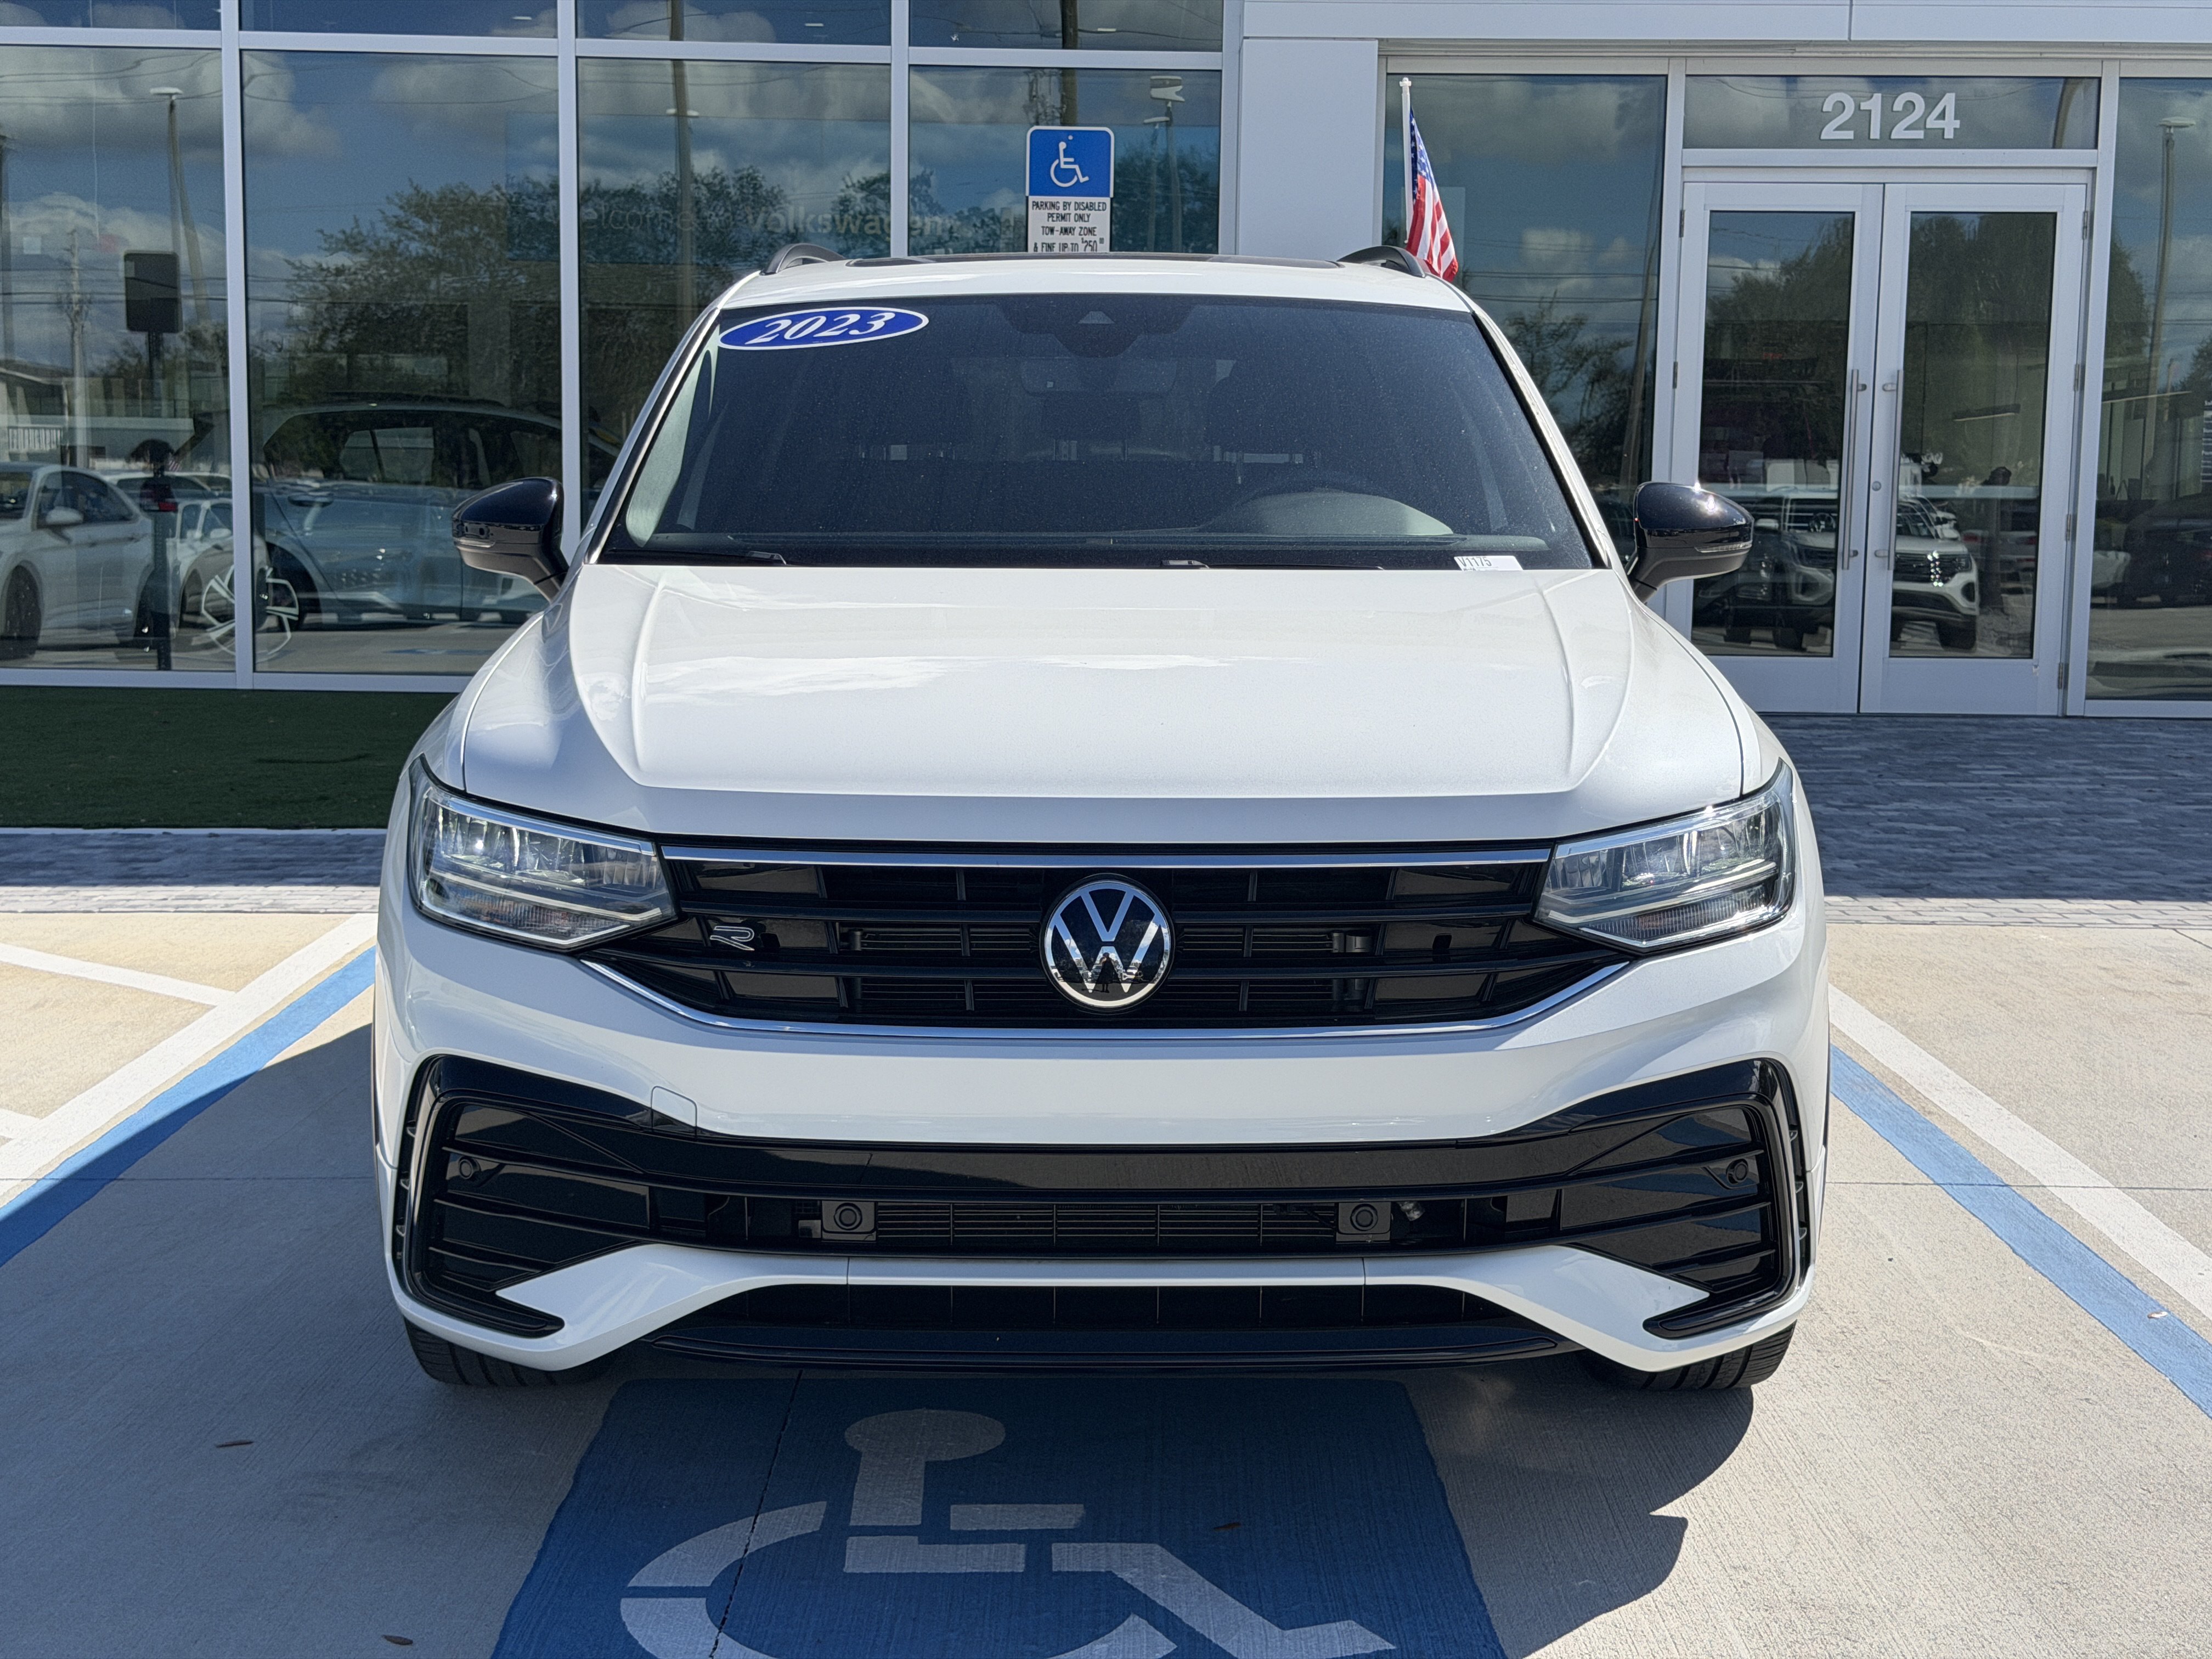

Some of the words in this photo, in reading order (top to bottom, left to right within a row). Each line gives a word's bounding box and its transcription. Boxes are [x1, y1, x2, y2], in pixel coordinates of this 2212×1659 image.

[1820, 92, 1960, 140] 2124
[1032, 201, 1060, 211] PARKING
[1063, 201, 1071, 211] BY
[1074, 201, 1107, 211] DISABLED
[1047, 213, 1071, 222] PERMIT
[1074, 213, 1091, 222] ONLY
[1041, 226, 1076, 236] TOW-AWAY
[1079, 227, 1097, 236] ZONE
[745, 312, 895, 345] 2023
[1457, 556, 1492, 567] V1175
